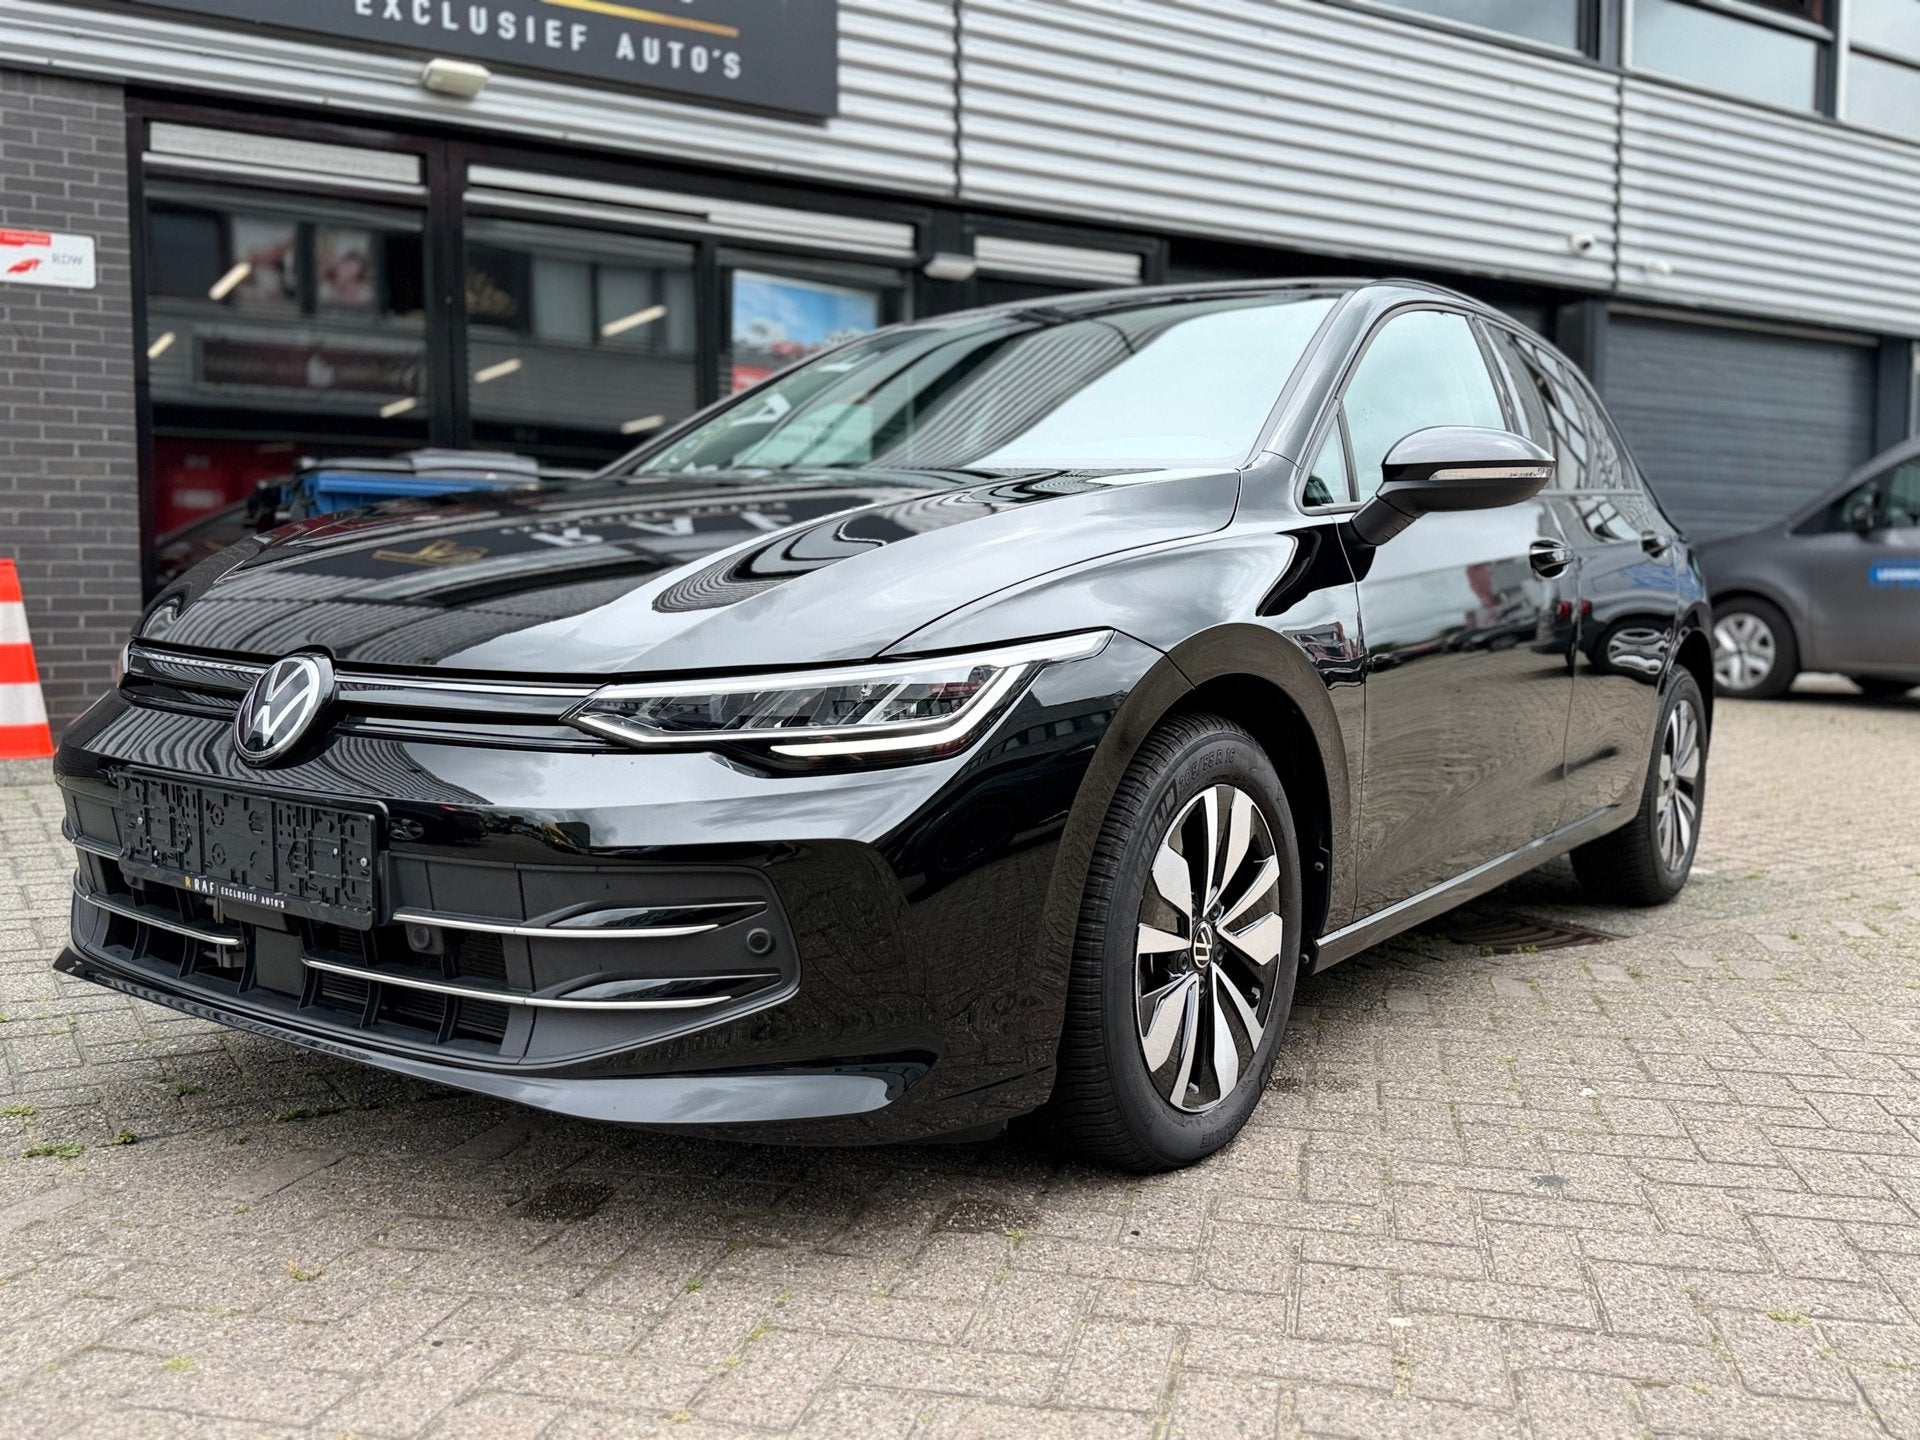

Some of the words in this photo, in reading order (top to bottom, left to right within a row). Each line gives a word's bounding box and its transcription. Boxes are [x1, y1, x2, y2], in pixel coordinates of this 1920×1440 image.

[354, 0, 588, 52] EXCLUSIEF
[615, 32, 742, 80] AUTO'S
[1225, 747, 1236, 764] 16
[194, 878, 215, 895] RAF
[220, 886, 258, 903] EXCLUSIEF
[261, 896, 286, 909] AUTO'S
